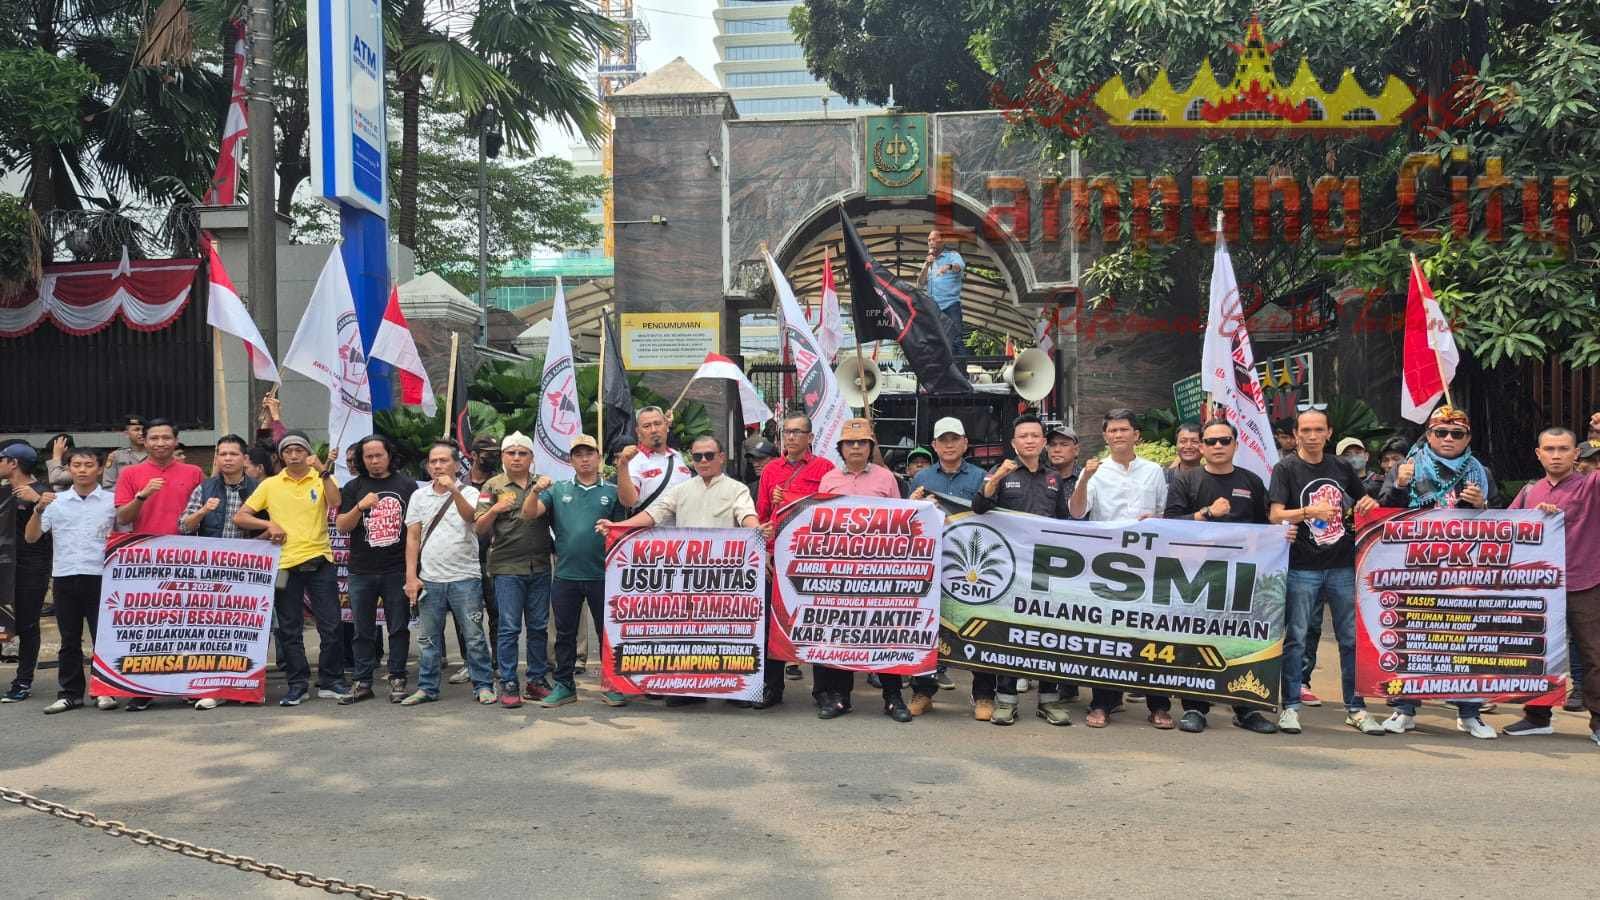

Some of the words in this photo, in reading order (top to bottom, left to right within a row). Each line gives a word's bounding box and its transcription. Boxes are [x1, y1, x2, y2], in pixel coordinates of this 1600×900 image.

[354, 34, 377, 72] ATM
[810, 506, 917, 535] DESAK
[1122, 531, 1159, 550] PT
[1382, 521, 1513, 542] KEJAGUNG
[1517, 521, 1543, 544] RI
[632, 539, 683, 567] KPK
[795, 535, 908, 558] KEJAGUNG
[911, 537, 935, 560] RI
[1406, 542, 1474, 565] KPK
[1478, 543, 1511, 566] RI
[117, 548, 151, 565] TATA
[156, 549, 207, 566] KELOLA
[211, 550, 272, 570] KEGIATAN
[112, 567, 121, 578] DI
[125, 567, 171, 579] DLHPPKP
[174, 568, 197, 579] KAB.
[200, 569, 244, 582] LAMPUNG
[248, 573, 272, 584] TIMUR
[796, 563, 827, 573] AMBIL
[830, 564, 852, 574] ALIH
[856, 564, 928, 576] PENANGANAN
[1373, 571, 1437, 586] LAMPUNG
[1441, 570, 1497, 585] DARURAT
[1501, 569, 1557, 584] KORUPSI
[621, 569, 675, 592] USUT
[681, 569, 757, 592] TUNTAS
[803, 580, 841, 592] KASUS
[844, 580, 892, 592] DUGAAN
[895, 580, 923, 593] TPPU
[1030, 544, 1257, 613] PSMI
[951, 582, 992, 599] PSMI
[124, 593, 182, 609] DIDUGA
[184, 594, 213, 609] JADI
[216, 595, 257, 610] LAHAN
[617, 595, 688, 620] SKANDAL
[691, 596, 760, 620] TAMBANG
[1407, 597, 1435, 605] KASUS
[1437, 599, 1477, 607] MANGKRAK
[1479, 600, 1506, 608] DIKEJATI
[1508, 600, 1542, 609] LAMPUNG
[112, 610, 183, 625] KORUPSI
[187, 611, 263, 627] BESAR2RAN
[803, 608, 867, 624] BUPATI
[869, 610, 921, 627] AKTIF
[1014, 596, 1102, 625] DALANG
[1111, 609, 1270, 641] PERAMBAHAN
[1407, 613, 1443, 621] PULUHAN
[1446, 614, 1471, 622] TAHUN
[1407, 621, 1423, 629] JADI
[1452, 623, 1476, 631] KORUP
[117, 630, 143, 640] YANG
[146, 630, 204, 640] DILAKUKAN
[207, 629, 231, 639] OLEH
[234, 630, 258, 641] OKNUM
[625, 624, 643, 635] YANG
[646, 624, 673, 634] TERJADI
[675, 625, 680, 634] DI
[699, 625, 729, 634] LAMPUNG
[731, 625, 752, 634] TIMUR
[792, 627, 826, 641] KAB.
[831, 629, 931, 644] PESAWARAN
[130, 641, 173, 652] PEJABAT
[177, 641, 196, 651] DAN
[199, 642, 232, 651] KOLEGA
[1008, 628, 1132, 658] REGISTER
[1139, 643, 1175, 664] 44
[1407, 642, 1448, 650] WAYKANAN
[1480, 644, 1498, 652] PSMI
[1428, 634, 1464, 642] LIBATKAN
[1467, 636, 1497, 644] MANTAN
[1500, 636, 1533, 645] PEJABAT
[623, 646, 652, 655] DIDUGA
[654, 646, 690, 655] LIBATKAN
[692, 646, 716, 655] ORANG
[719, 646, 752, 655] TERDEKAT
[808, 650, 869, 662] #ALAMBAKA
[872, 651, 914, 662] LAMPUNG
[122, 656, 183, 672] PERIKSA
[187, 656, 216, 671] DAN
[219, 656, 247, 671] ADILI
[621, 656, 664, 672] BUPATI
[667, 656, 720, 671] LAMPUNG
[723, 656, 754, 671] TIMUR
[981, 651, 1056, 672] KABUPATEN
[1060, 662, 1088, 677] WAY
[1091, 666, 1137, 682] KANAN
[1149, 673, 1215, 690] LAMPUNG
[1408, 663, 1452, 671] SEADIL-ADIL
[1453, 657, 1496, 666] SUPREMASI
[1498, 659, 1527, 667] HUKUM
[232, 679, 259, 687] LAMPUNG
[647, 678, 697, 688] #ALAMBAKA
[699, 678, 737, 688] LAMPUNG
[1388, 680, 1478, 694] #ALAMBAKA
[1482, 679, 1548, 692] LAMPUNG
